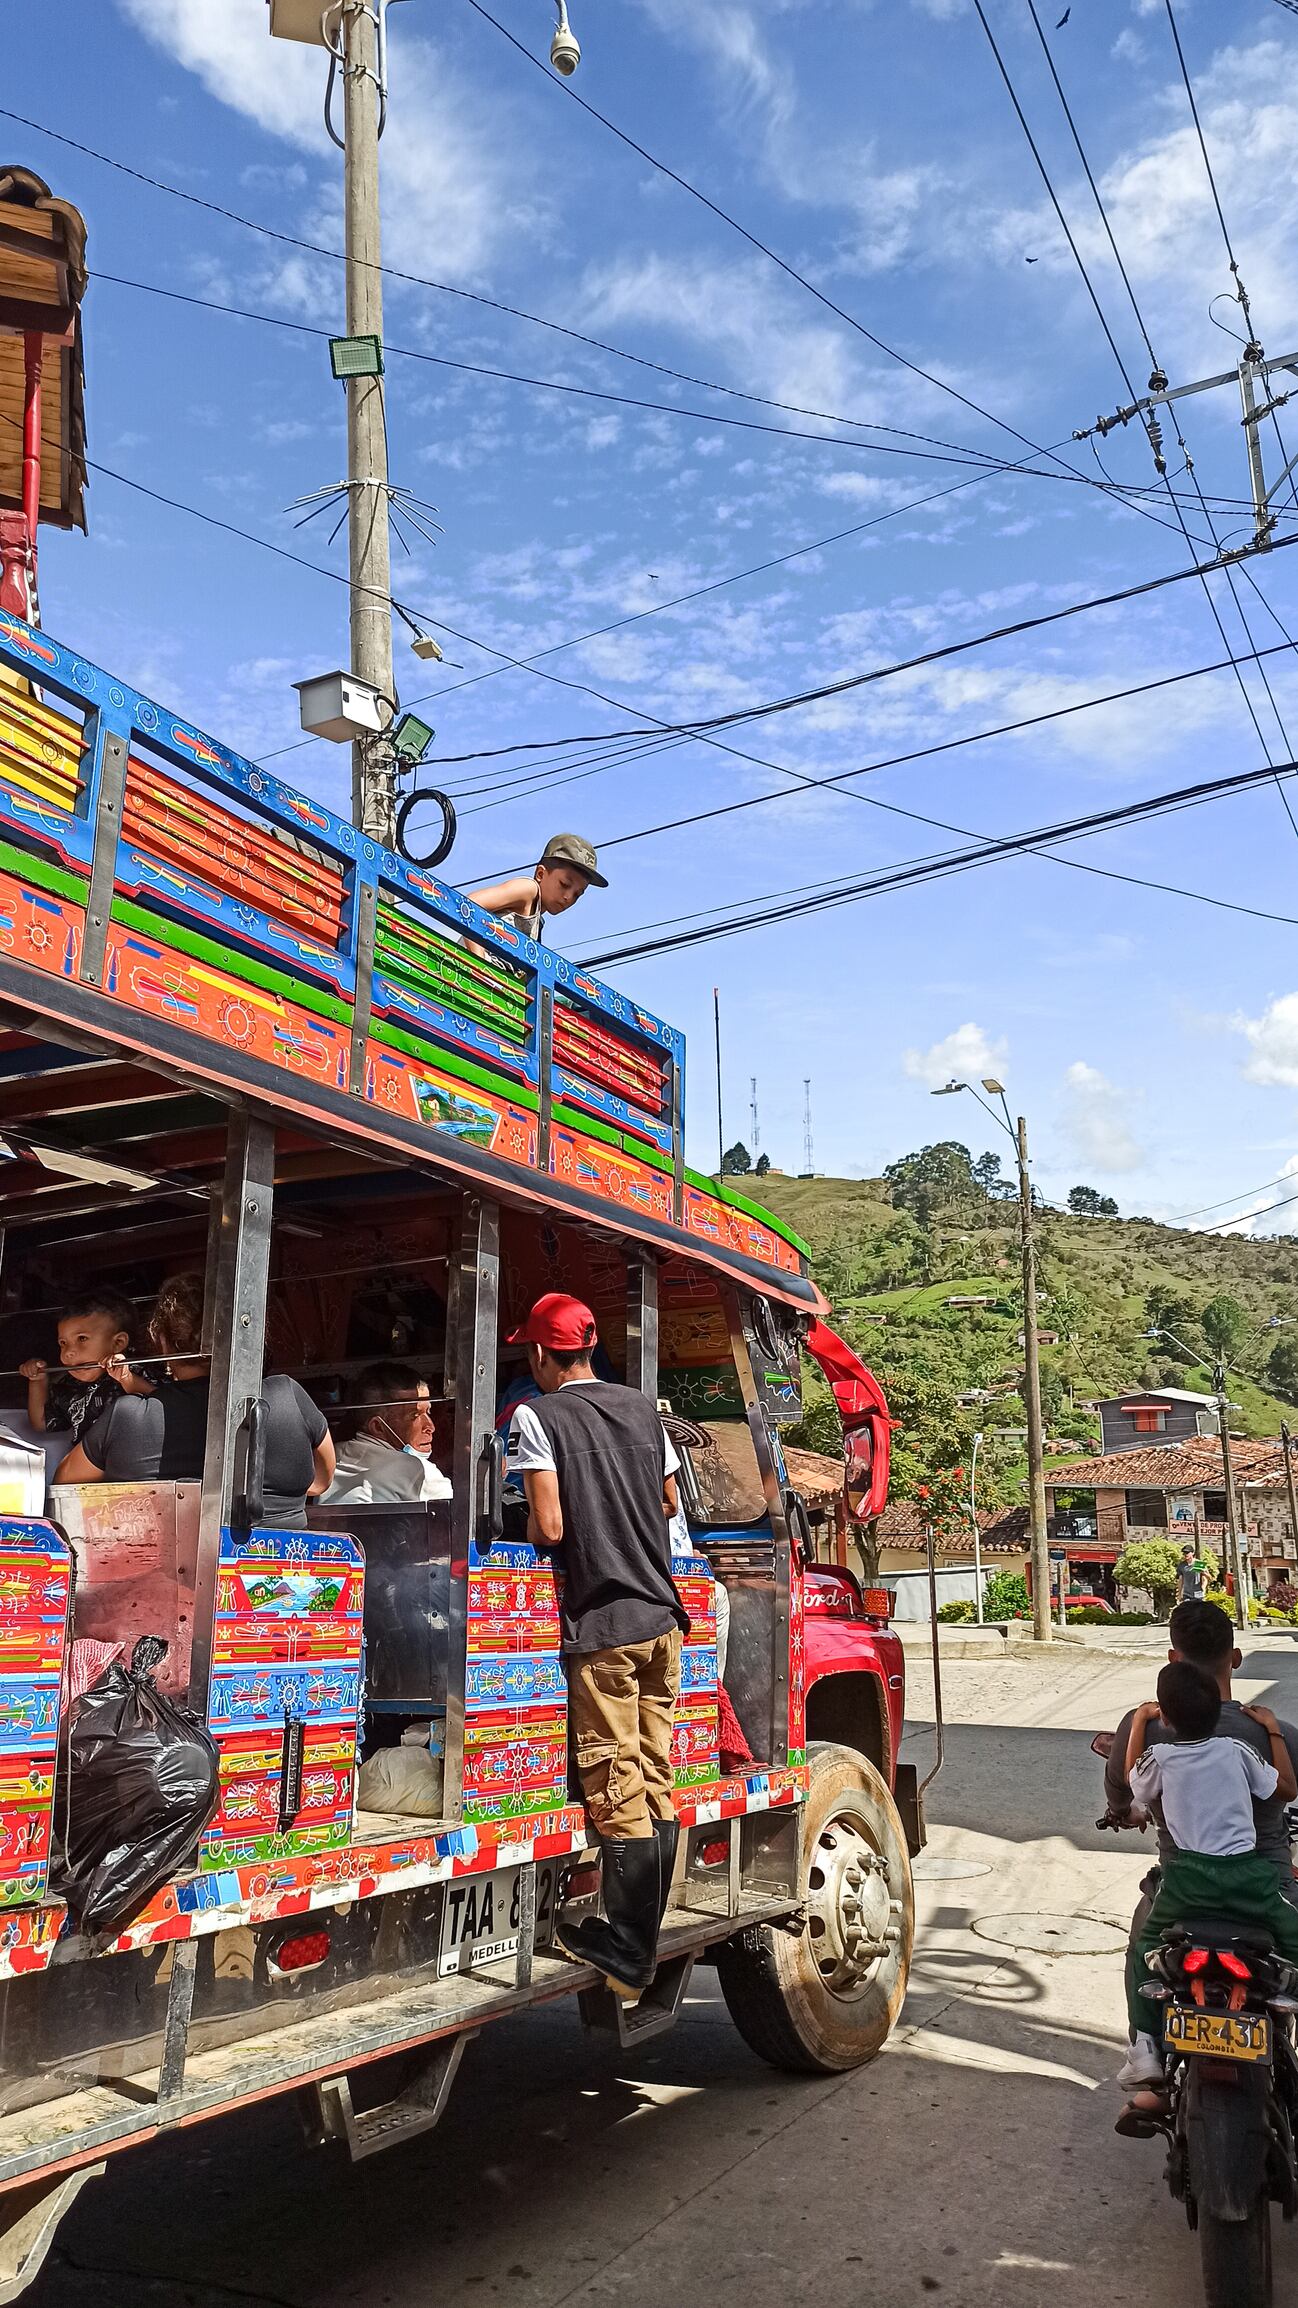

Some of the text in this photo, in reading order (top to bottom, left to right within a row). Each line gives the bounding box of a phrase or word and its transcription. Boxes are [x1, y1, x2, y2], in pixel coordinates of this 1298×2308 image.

[803, 1588, 840, 1607] ord
[448, 1868, 552, 1946] TAA 82
[468, 1938, 519, 1963] MEDELLI
[1196, 2042, 1235, 2054] COLOMBIA
